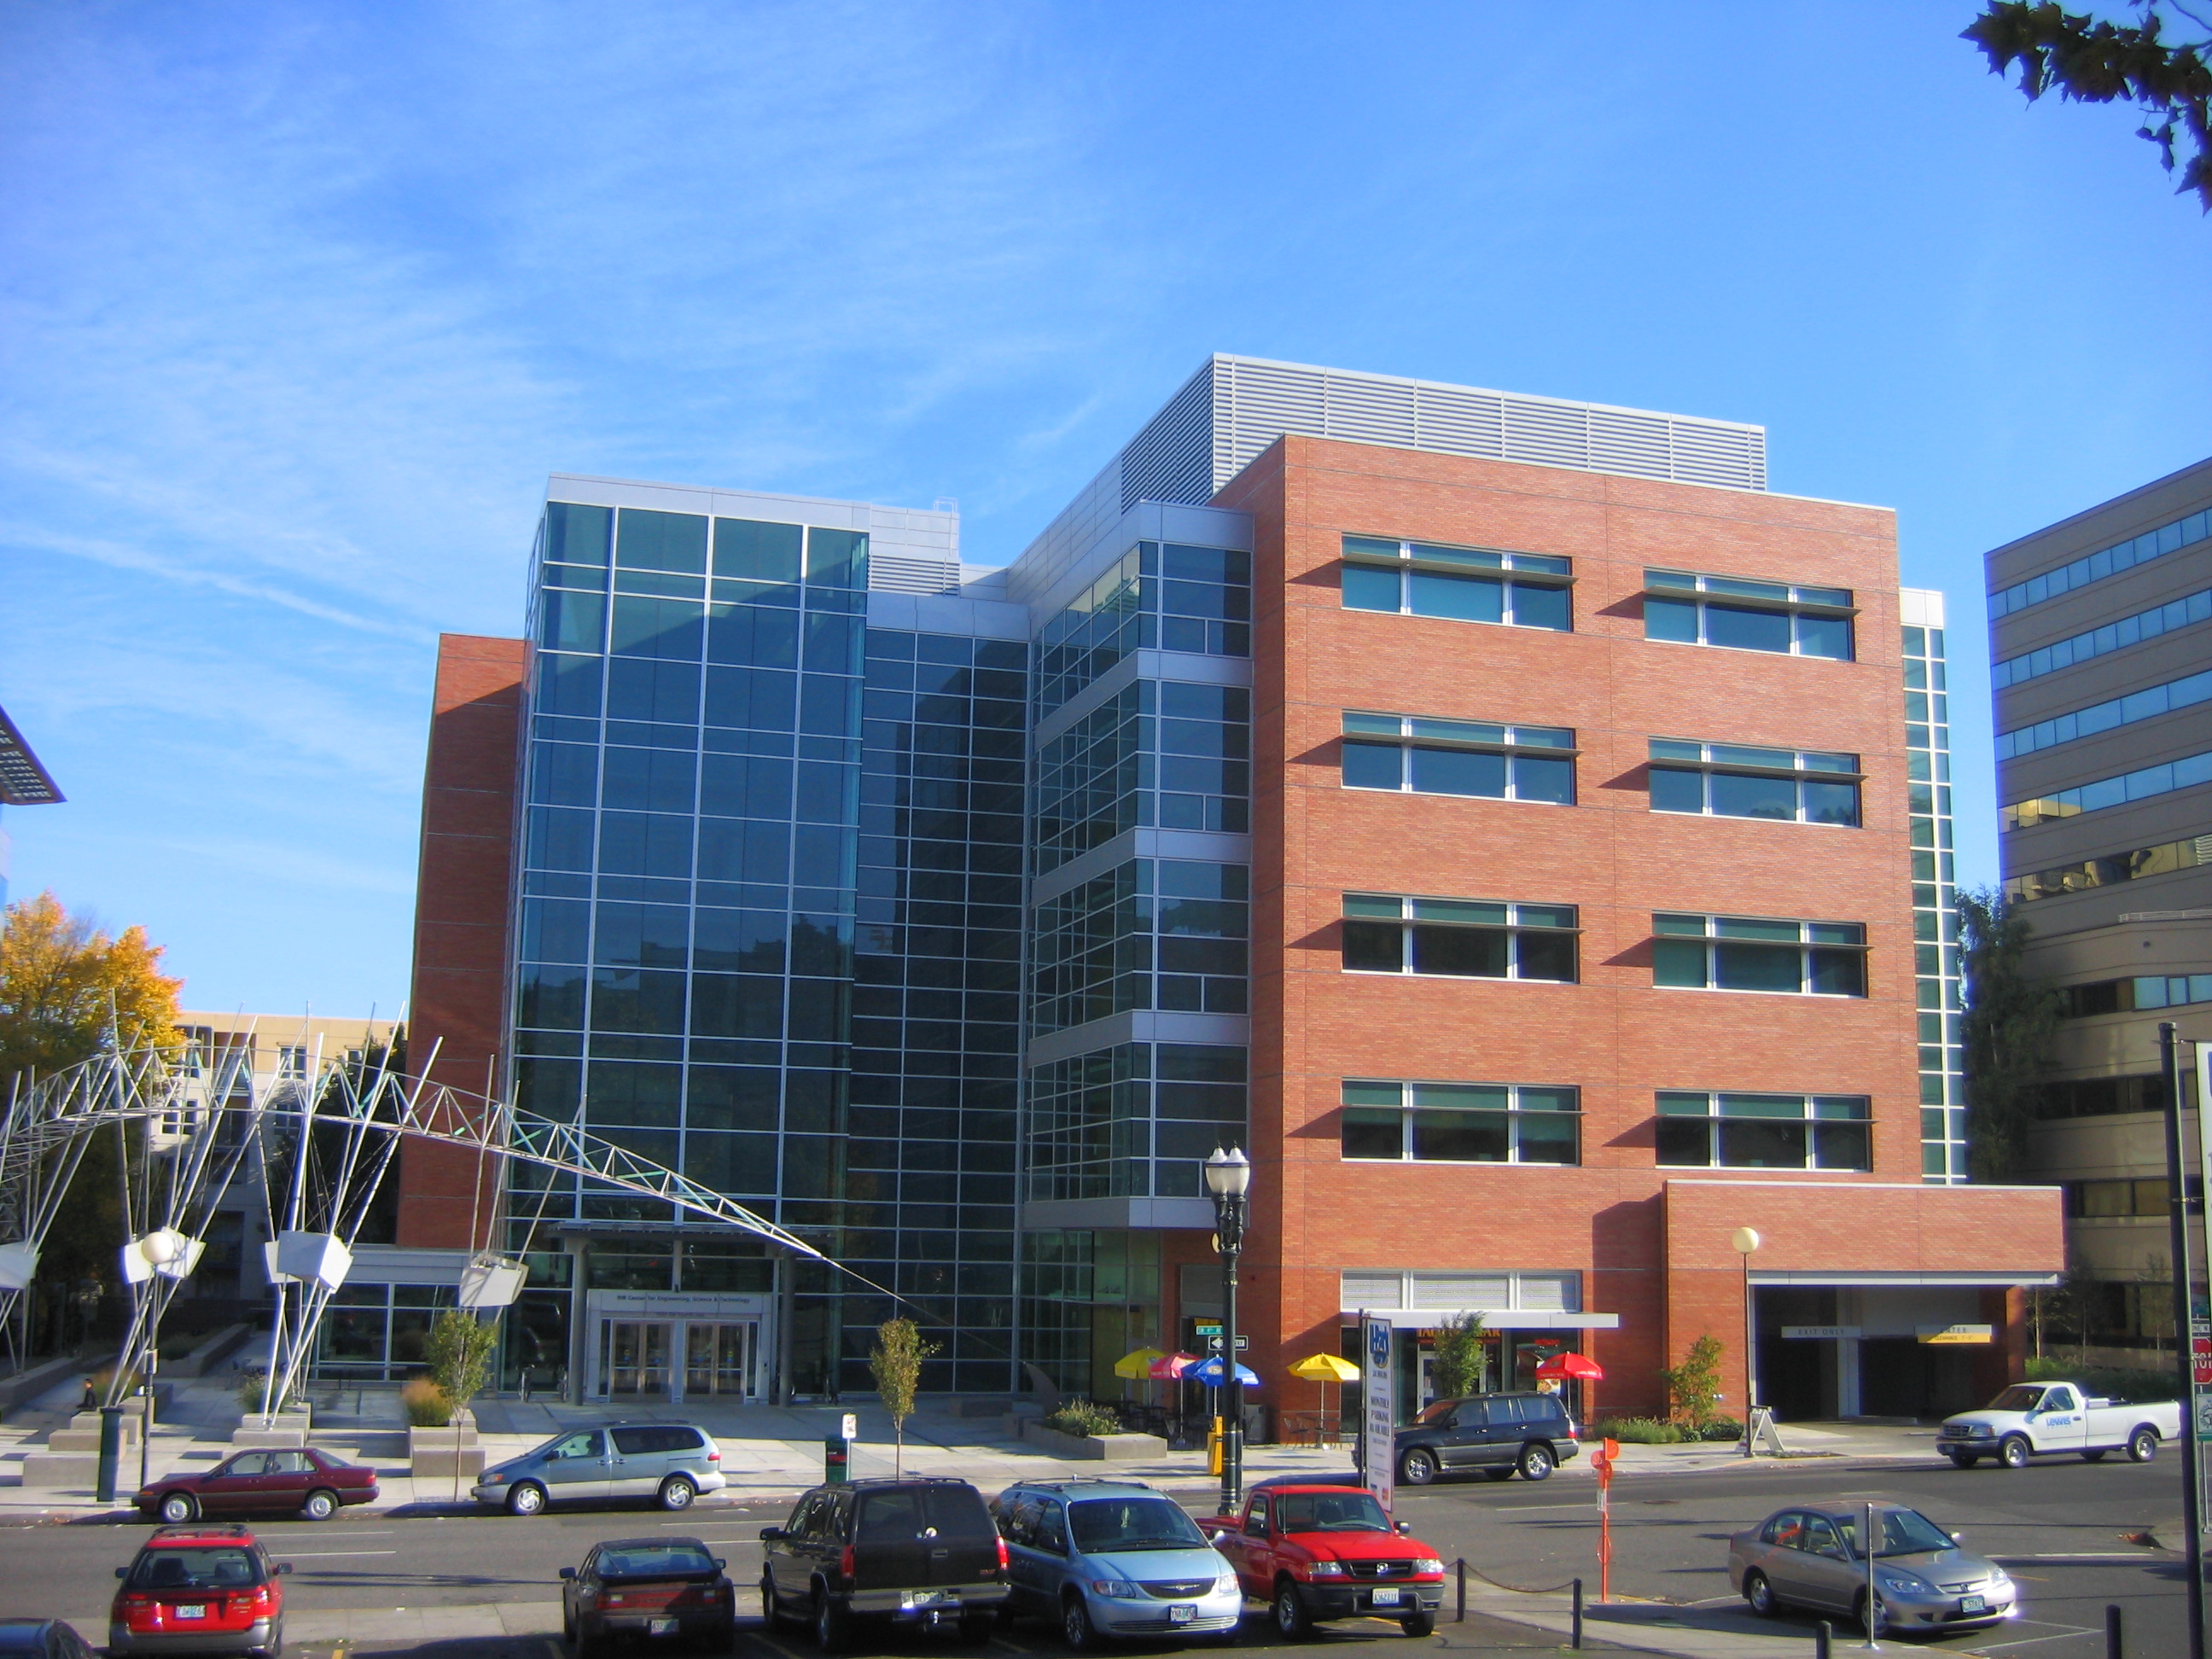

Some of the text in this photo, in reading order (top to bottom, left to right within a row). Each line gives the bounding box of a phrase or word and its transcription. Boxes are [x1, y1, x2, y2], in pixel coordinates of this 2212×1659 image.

[1371, 1395, 1389, 1409] MONTHLY
[1371, 1409, 1389, 1423] PARKING
[1370, 1423, 1390, 1437] AVAILABLE
